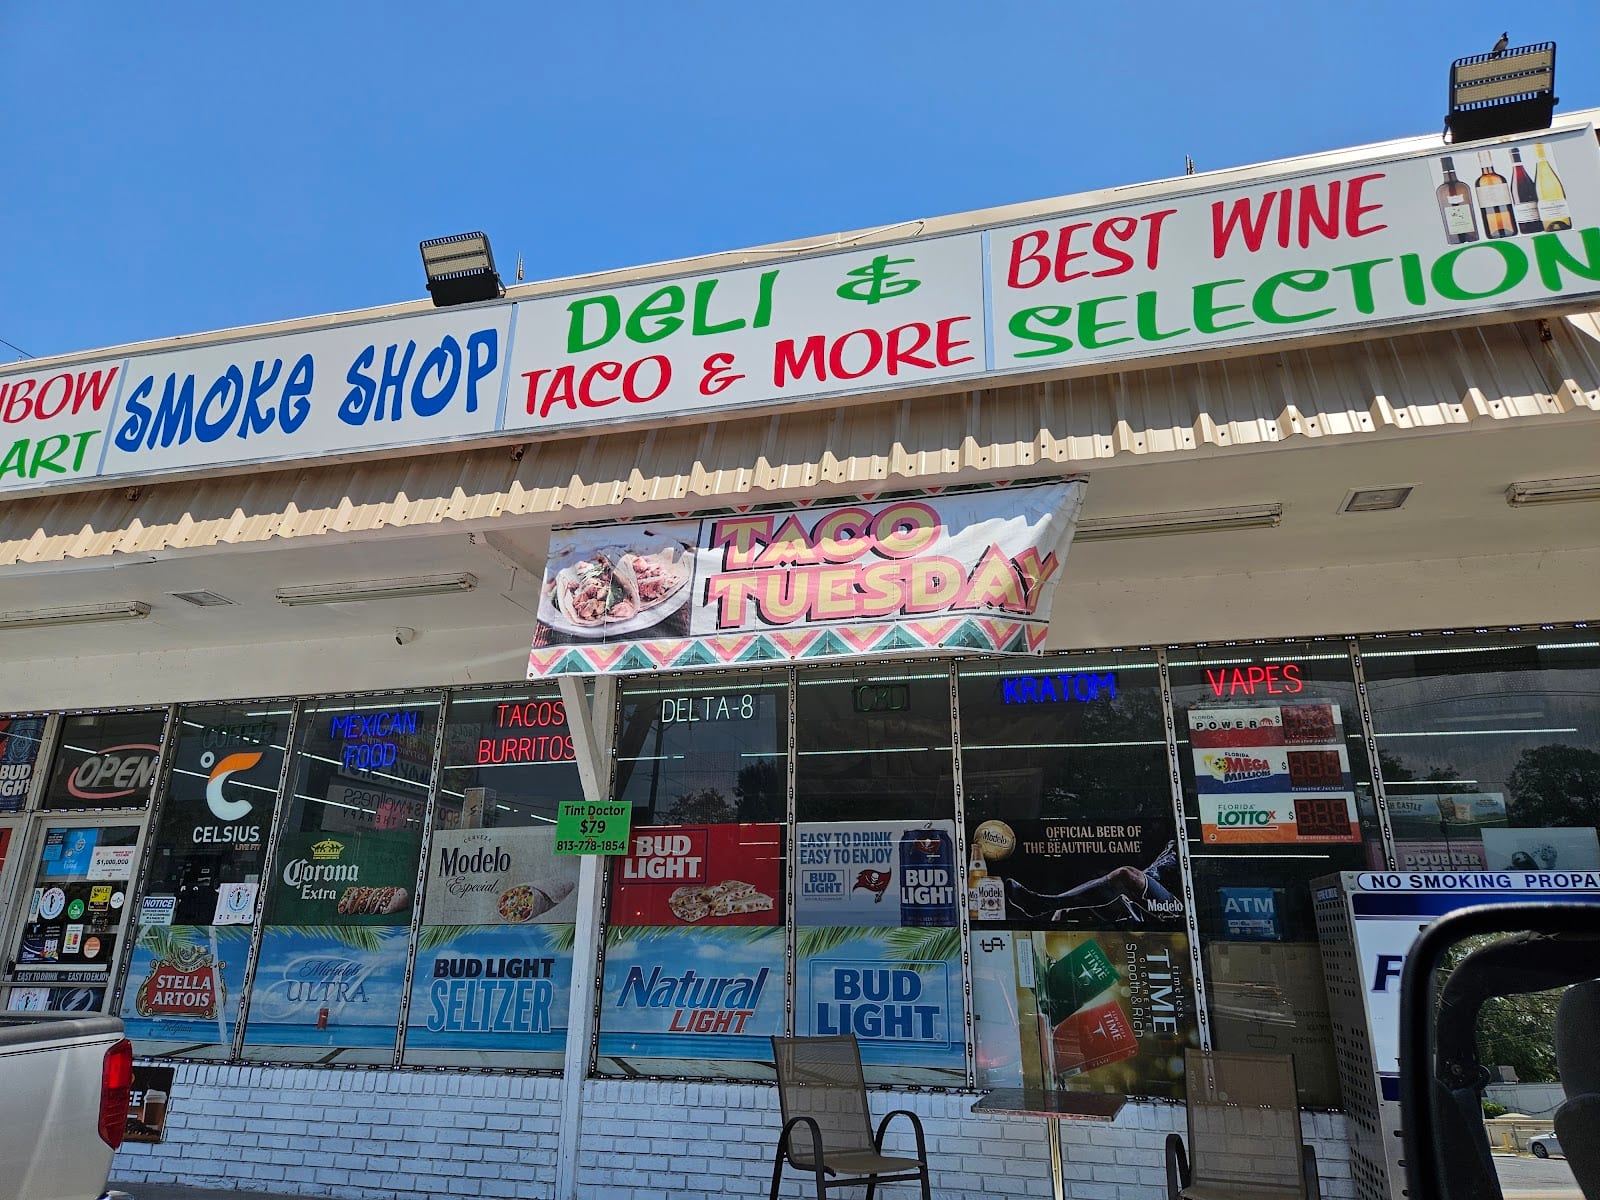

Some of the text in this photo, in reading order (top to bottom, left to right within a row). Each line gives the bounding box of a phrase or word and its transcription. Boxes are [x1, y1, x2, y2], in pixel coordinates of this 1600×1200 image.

[1007, 173, 1388, 289] BEST WINE
[1007, 227, 1600, 359] SELECTION
[338, 328, 498, 426] SHOP
[521, 316, 975, 418] TACO & MORE
[709, 501, 942, 568] TACO
[703, 542, 1059, 629] TUESDAY
[1002, 672, 1117, 705] KRATOM
[1206, 664, 1304, 697] VAPES
[496, 701, 565, 728] TACOS
[661, 694, 754, 723] DELTA-8
[330, 711, 419, 740] MEXICAN
[343, 743, 398, 769] FOOD
[478, 735, 576, 764] BURRITOS
[75, 756, 157, 788] OPEN
[1224, 769, 1271, 783] MILLIONS
[1227, 757, 1270, 772] MEGA
[564, 805, 625, 816] Tint Doctor
[192, 825, 260, 844] CELSIUS
[463, 832, 493, 844] CERVEZA
[579, 820, 606, 834] $79
[982, 830, 1007, 845] Modelo
[1045, 825, 1142, 839] OFFICIAL BEER OF
[556, 840, 625, 851] 813-778-1854
[635, 835, 693, 857] BUD
[800, 831, 893, 848] EASY TO DRINK
[1023, 841, 1141, 854] THE BEAUTIFUL GAME
[438, 845, 511, 877] Modelo
[623, 857, 702, 879] LIGHT
[800, 848, 893, 865] EASY TO ENJOY
[283, 858, 360, 890] Corona
[809, 871, 837, 883] BUD
[905, 869, 949, 887] BUD
[1371, 873, 1600, 888] NO SMOKING PROPA
[300, 884, 337, 901] Extra
[446, 876, 498, 899] Especial
[804, 882, 842, 894] LIGHT
[901, 886, 953, 905] LIGHT
[143, 898, 174, 908] NOTICE
[1147, 899, 1184, 912] Modelo
[1224, 897, 1274, 913] ATM
[17, 972, 33, 982] EASY
[67, 972, 84, 982] EASY
[300, 959, 360, 979] Michelob
[433, 958, 555, 978] BUD LIGHT
[1083, 950, 1107, 981] TIME
[156, 975, 212, 991] STELLA
[286, 980, 369, 1003] ULTRA
[616, 966, 770, 1010] Natural
[833, 968, 922, 1002] BUD
[1125, 943, 1144, 1039] Smooth & Rich
[1138, 957, 1152, 1031] CIGARETTE
[1146, 944, 1178, 1035] TIME
[1172, 965, 1184, 1019] timeless
[152, 992, 210, 1007] ARTOIS
[426, 978, 554, 1033] SELTZER
[668, 1009, 753, 1034] LIGHT
[816, 1002, 941, 1040] LIGHT
[1103, 1012, 1122, 1042] TIME
